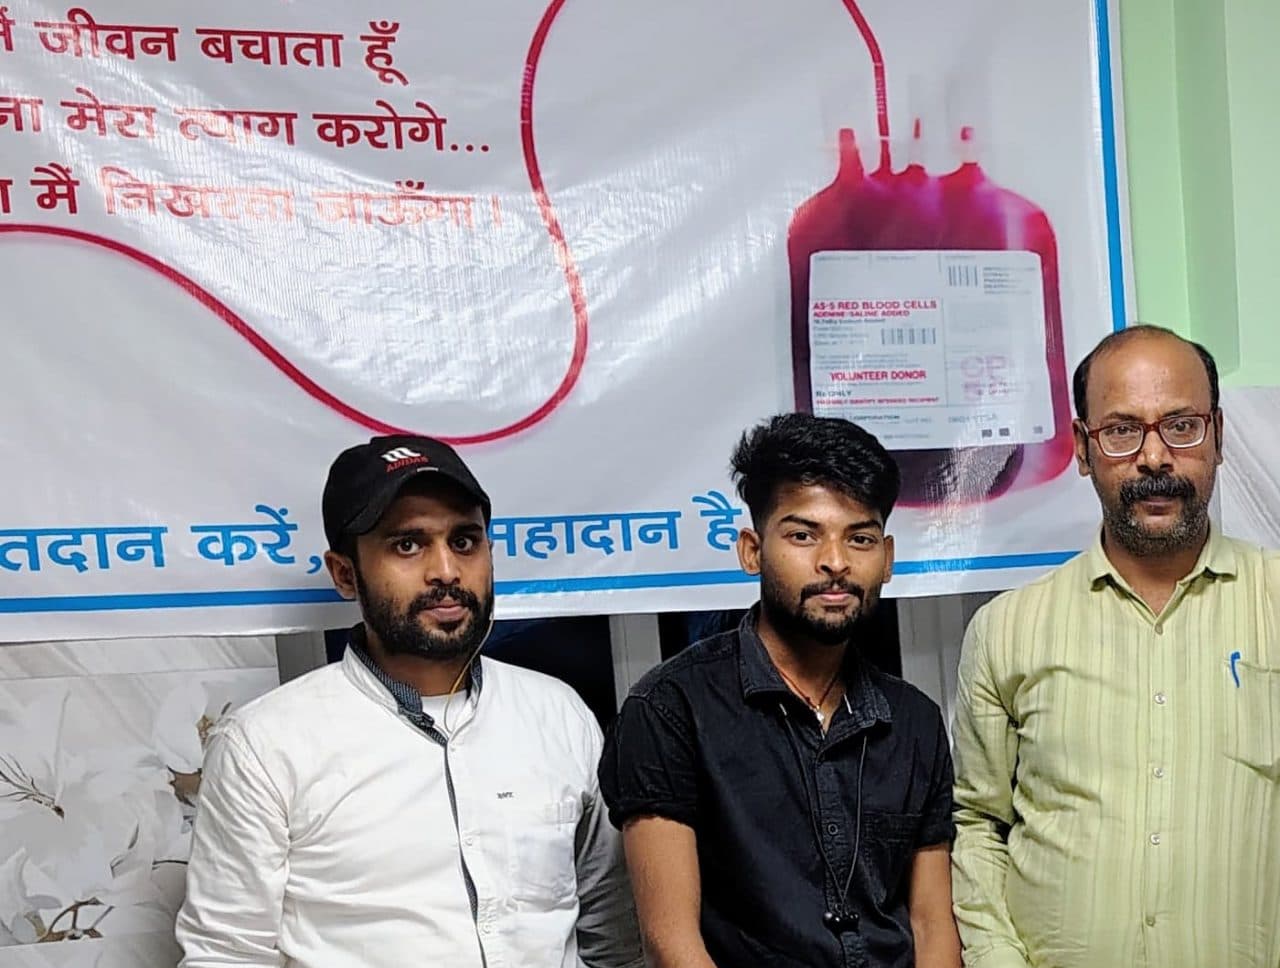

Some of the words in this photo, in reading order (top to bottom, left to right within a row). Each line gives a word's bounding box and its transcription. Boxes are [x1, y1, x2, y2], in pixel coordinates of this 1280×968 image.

[34, 8, 178, 62] जीवन
[196, 27, 343, 67] बचाता
[360, 21, 409, 84] हूँ
[60, 87, 154, 140] मेरा
[178, 105, 297, 146] त्याग
[312, 101, 490, 152] करोगे...
[30, 163, 80, 214] मैं
[838, 301, 859, 310] RED
[862, 300, 900, 310] BLOOD
[903, 300, 937, 309] CELLS
[830, 371, 888, 381] VOLUNTEER
[891, 370, 926, 380] DONOR
[190, 505, 322, 574] करें,
[488, 511, 681, 559] महादान
[692, 491, 742, 550] है
